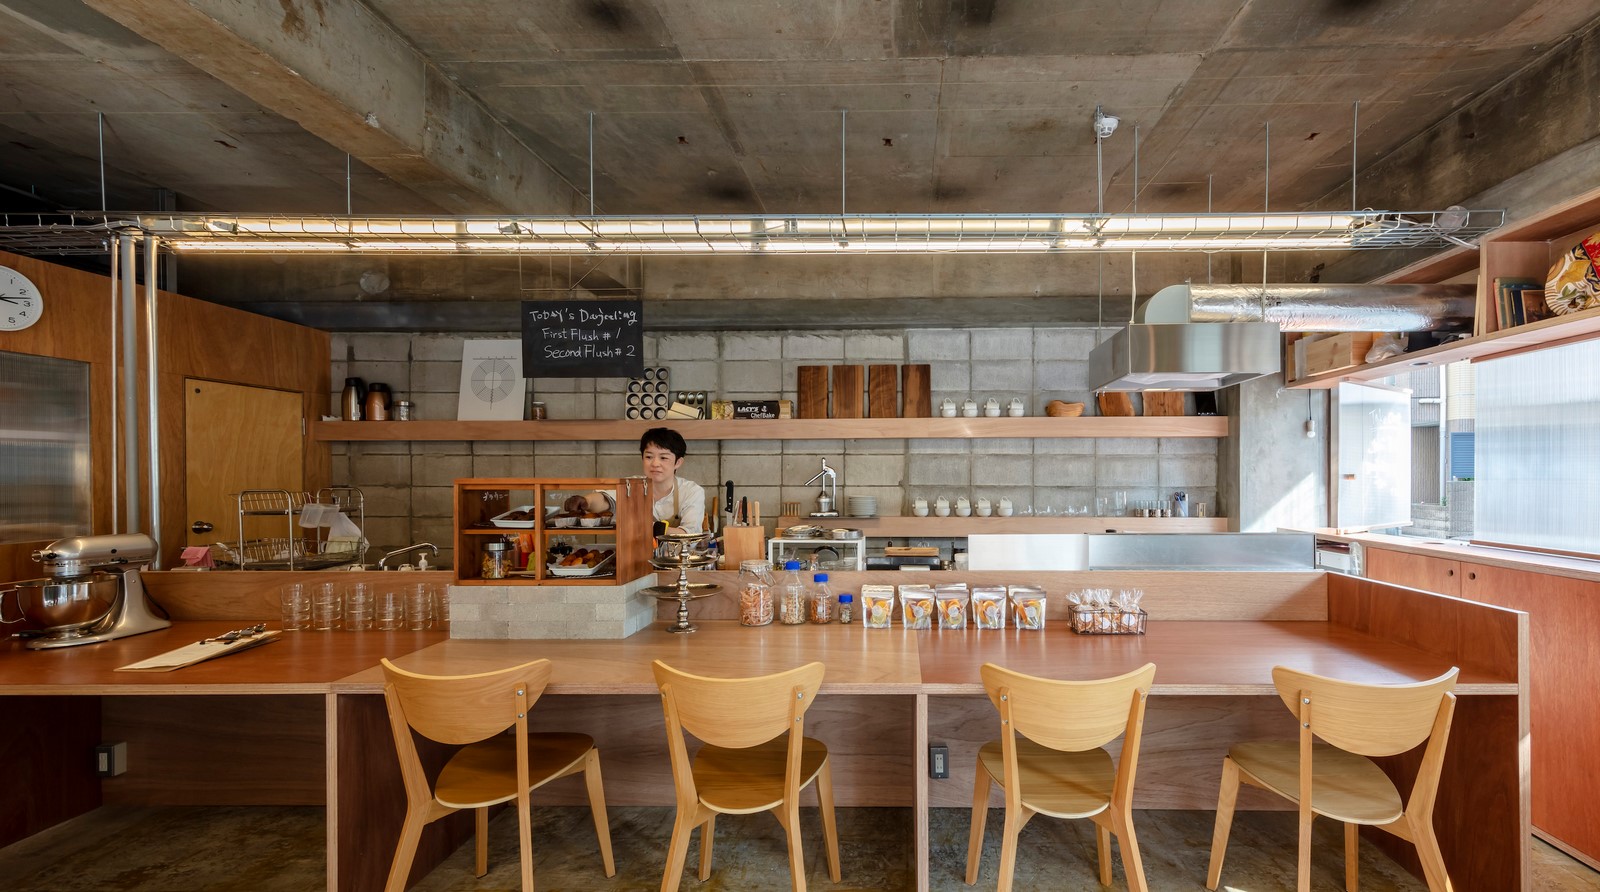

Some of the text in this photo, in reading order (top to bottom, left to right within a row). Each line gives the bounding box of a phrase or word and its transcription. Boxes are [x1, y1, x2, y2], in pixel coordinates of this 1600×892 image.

[541, 327, 567, 340] First
[570, 328, 600, 341] Flush
[543, 345, 582, 358] Second
[584, 344, 614, 358] Flush
